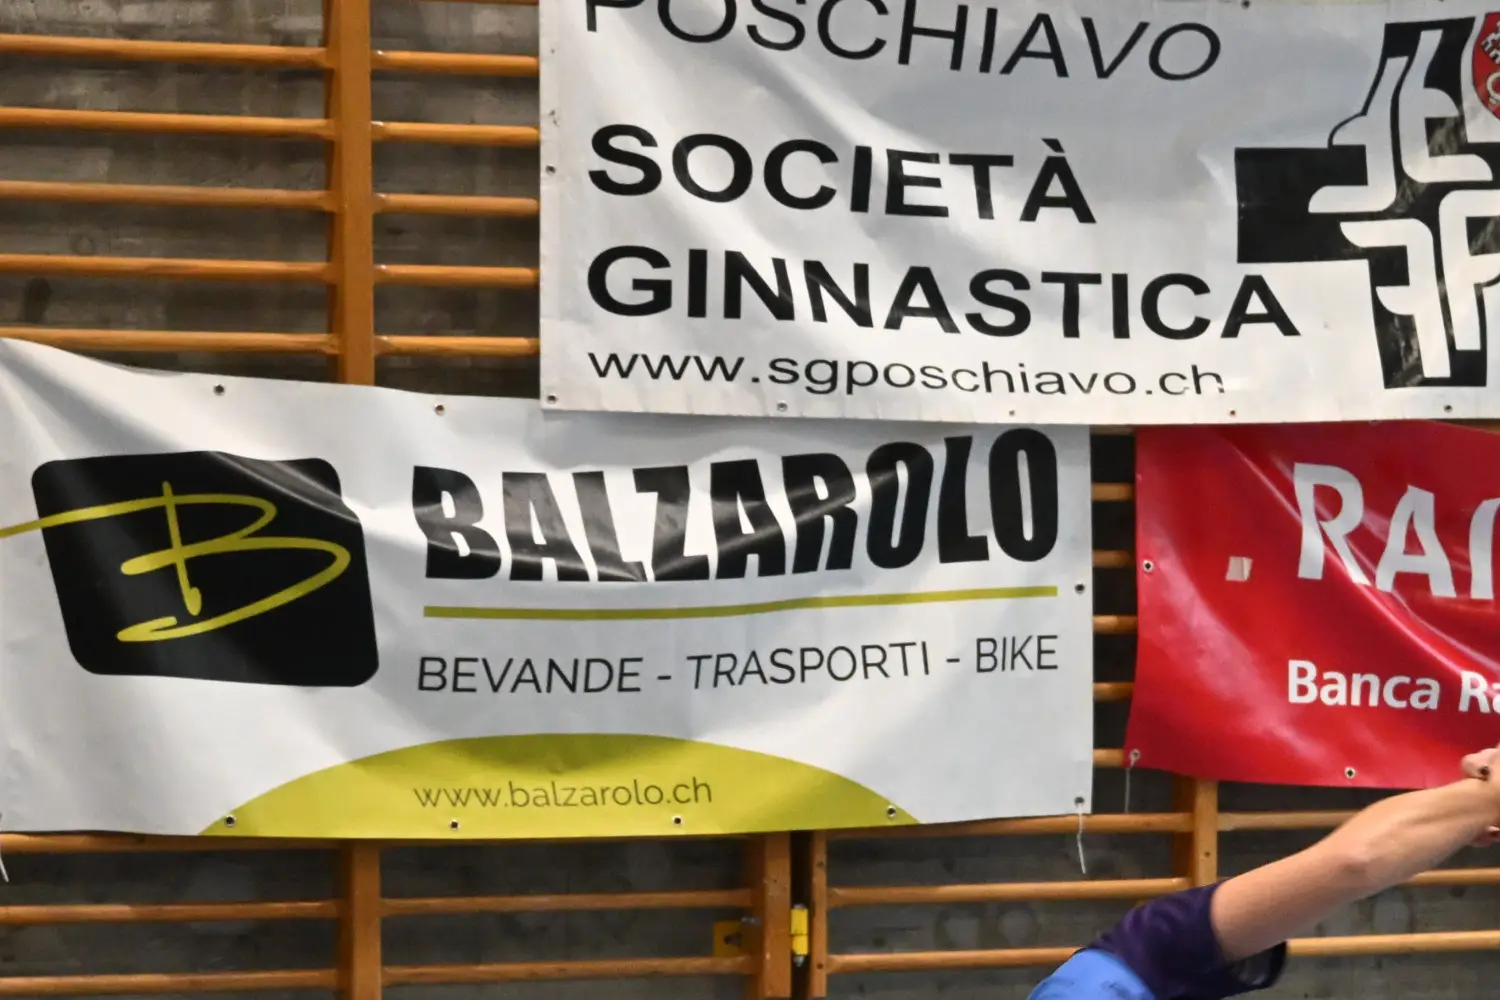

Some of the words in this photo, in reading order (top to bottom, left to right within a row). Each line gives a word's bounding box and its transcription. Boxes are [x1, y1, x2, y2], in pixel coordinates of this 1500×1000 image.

[588, 124, 1096, 223] SOCIETÀ
[587, 245, 1300, 340] GINNASTICA
[588, 352, 1225, 396] www.sgposchiavo.ch
[412, 427, 1059, 583] BALZAROLO
[417, 656, 644, 694] BEVANDE
[686, 641, 930, 690] TRASPORTI
[975, 634, 1059, 675] BIKE
[1287, 659, 1440, 711] Banca
[412, 776, 713, 808] www.balzarolo.ch
